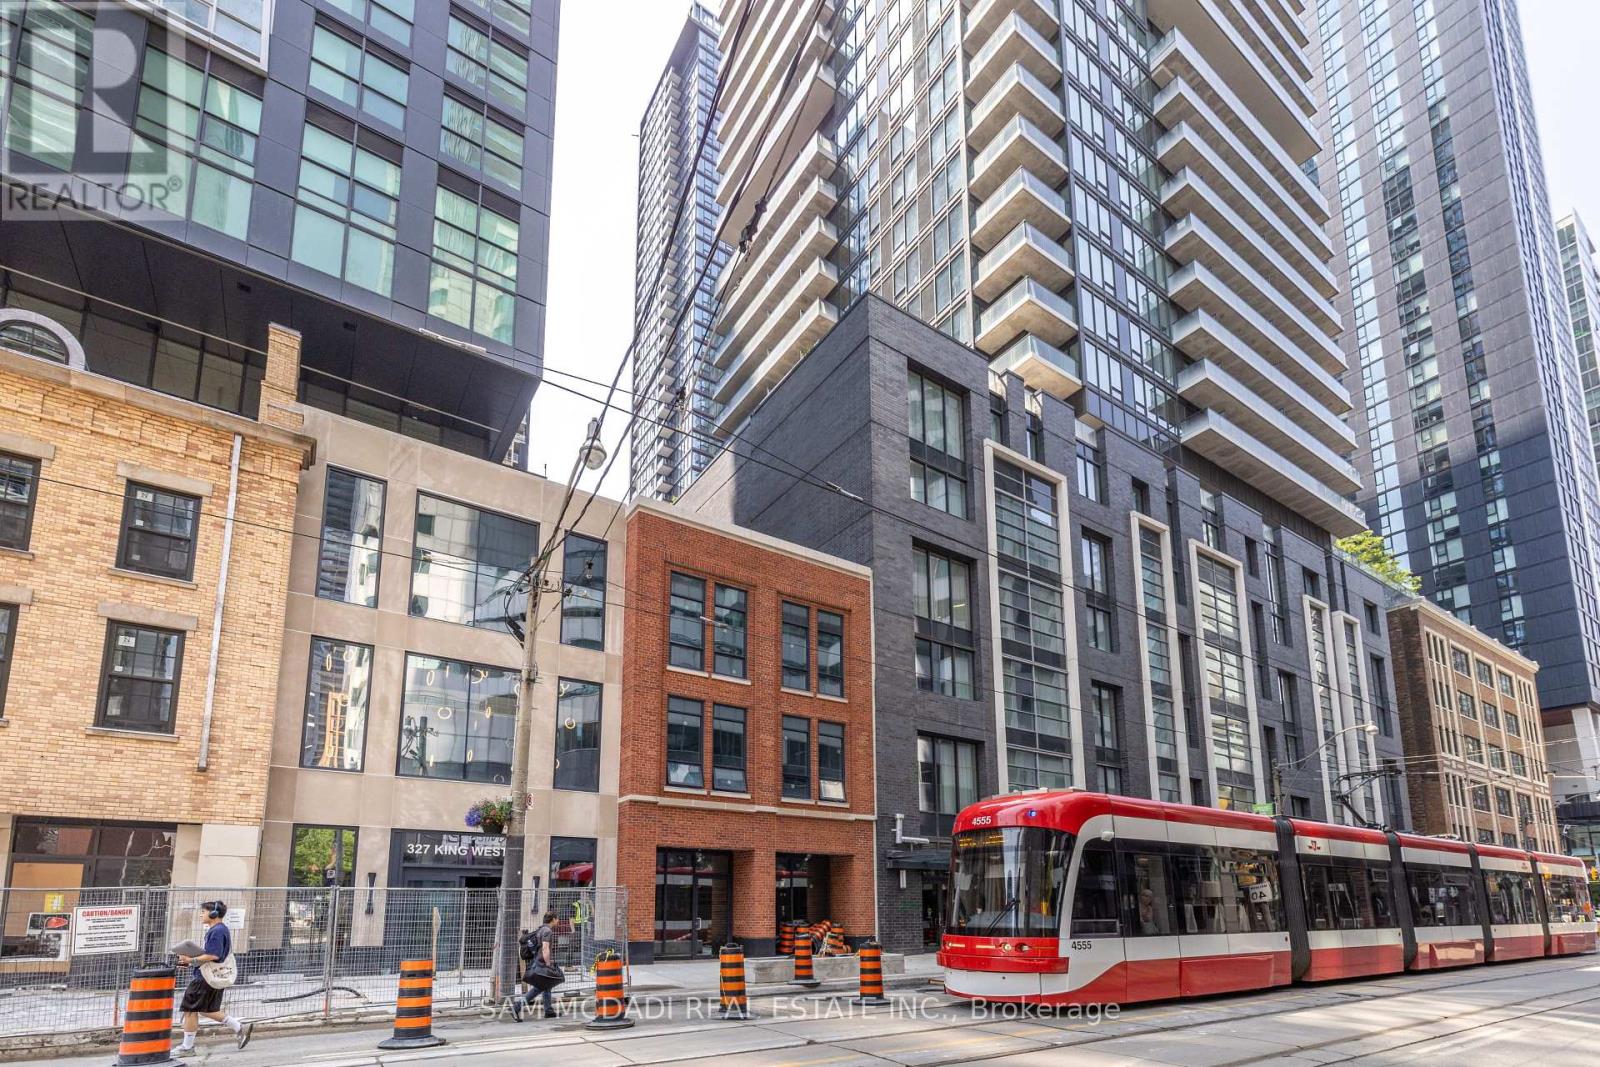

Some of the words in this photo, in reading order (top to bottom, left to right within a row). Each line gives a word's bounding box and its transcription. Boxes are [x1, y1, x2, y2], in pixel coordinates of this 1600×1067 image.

[972, 815, 992, 825] 4555
[407, 843, 430, 854] 327
[434, 845, 468, 855] KING
[471, 846, 506, 857] WEST
[1071, 940, 1092, 951] 4555
